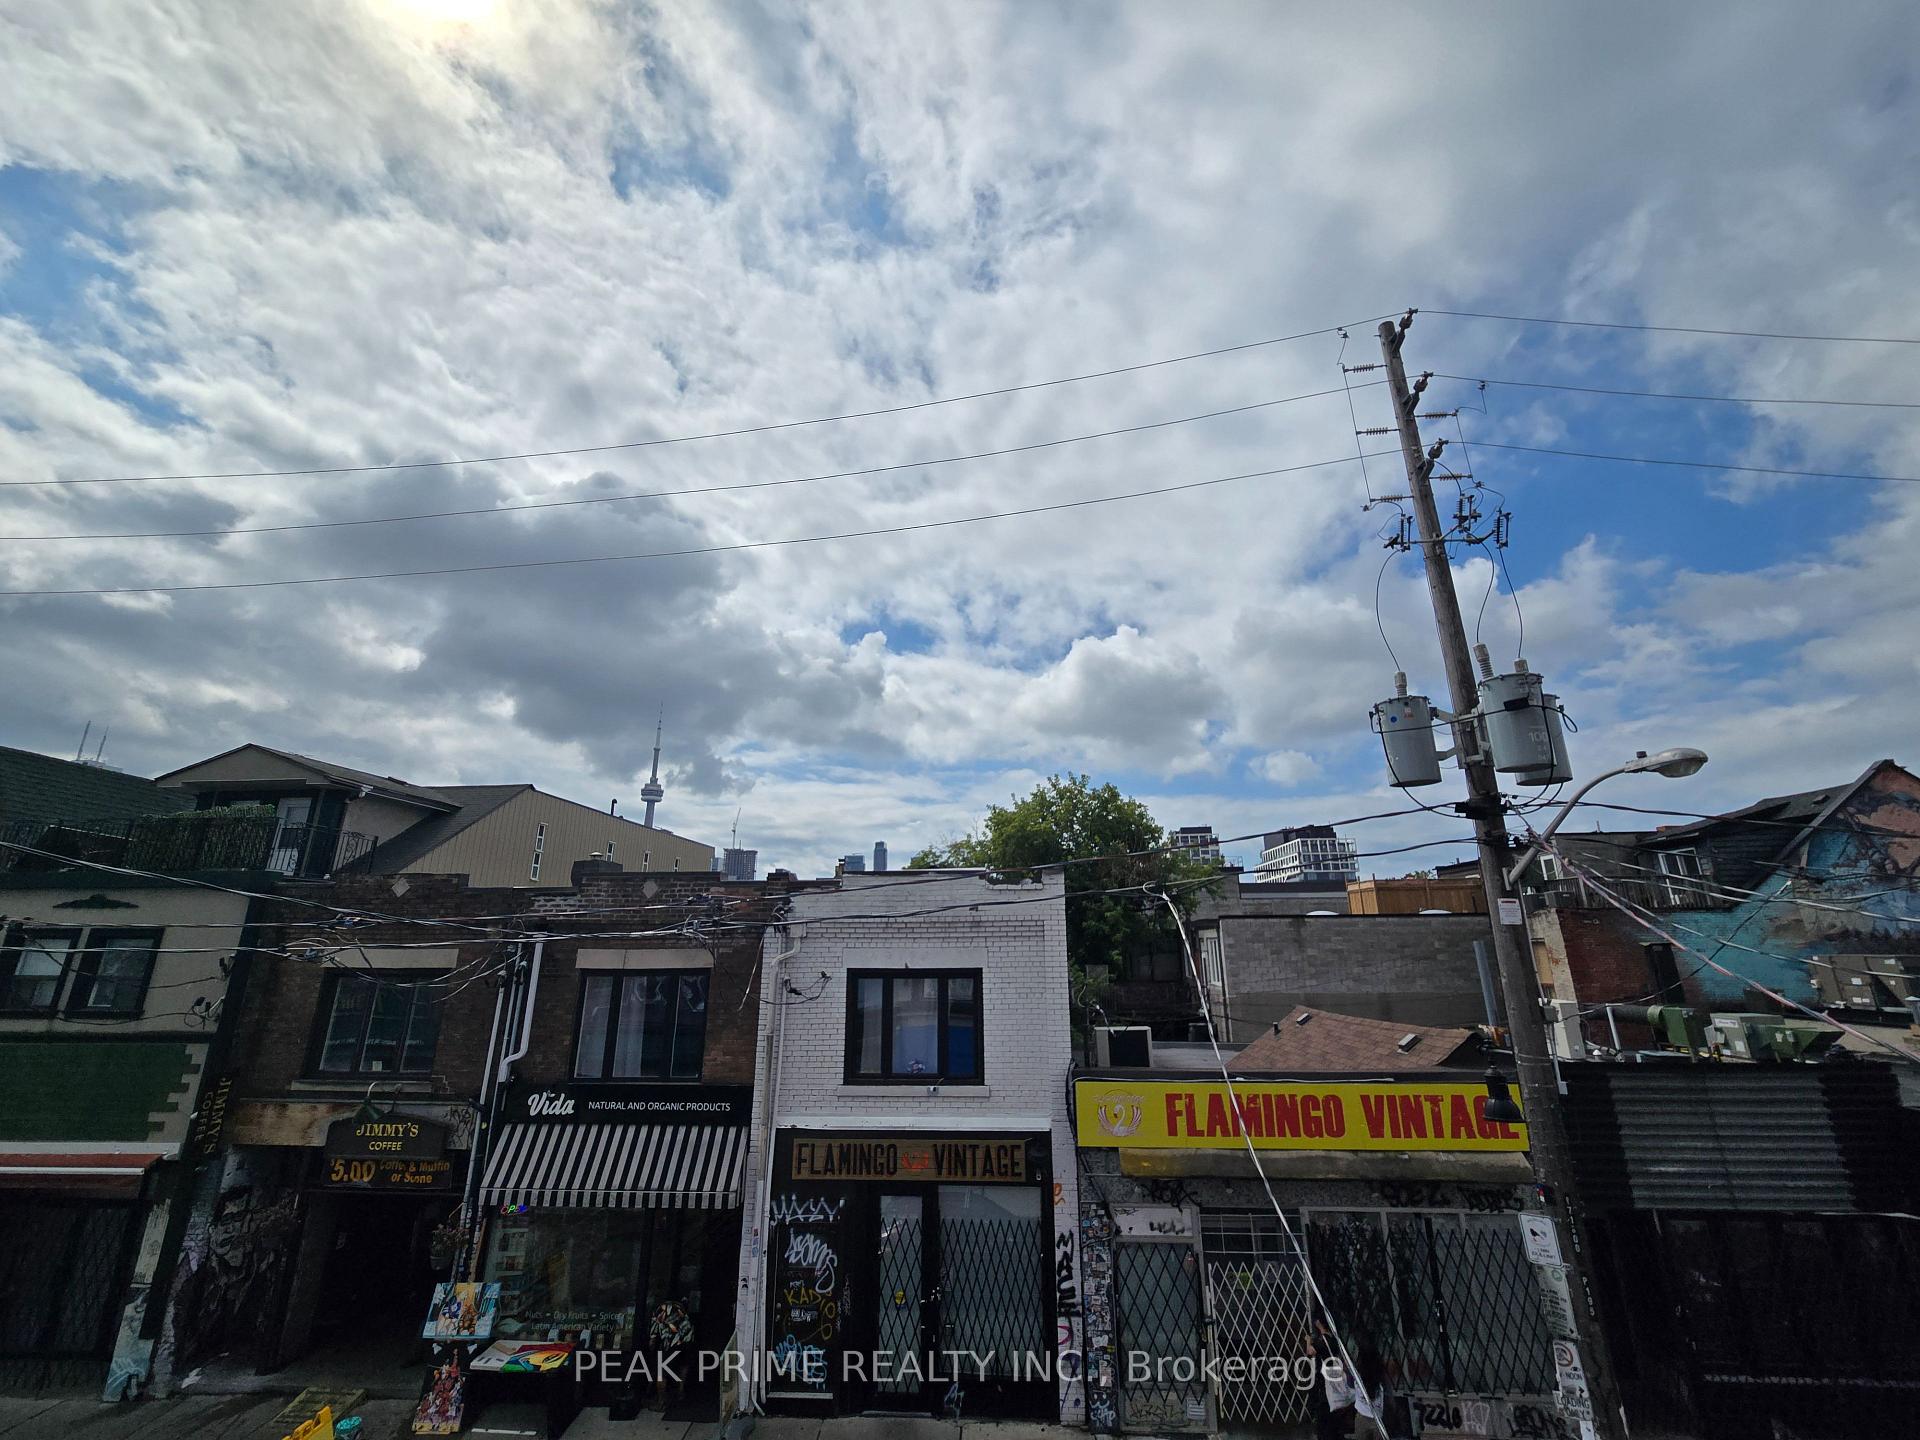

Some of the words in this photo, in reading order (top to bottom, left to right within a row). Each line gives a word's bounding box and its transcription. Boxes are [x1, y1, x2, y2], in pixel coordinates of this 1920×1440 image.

[528, 1090, 575, 1116] Vida
[588, 1101, 626, 1111] NATURAL
[627, 1102, 646, 1111] AND
[647, 1102, 684, 1111] ORGANIC
[686, 1102, 731, 1112] PRODUCTS
[1165, 1093, 1346, 1138] FLAMINGO
[356, 1122, 419, 1138] JIMMY'S
[368, 1141, 402, 1151] COFFEE
[796, 1143, 898, 1176] FLAMINGO
[933, 1144, 1022, 1177] VINTAGE
[1556, 1395, 1590, 1409] LOADING
